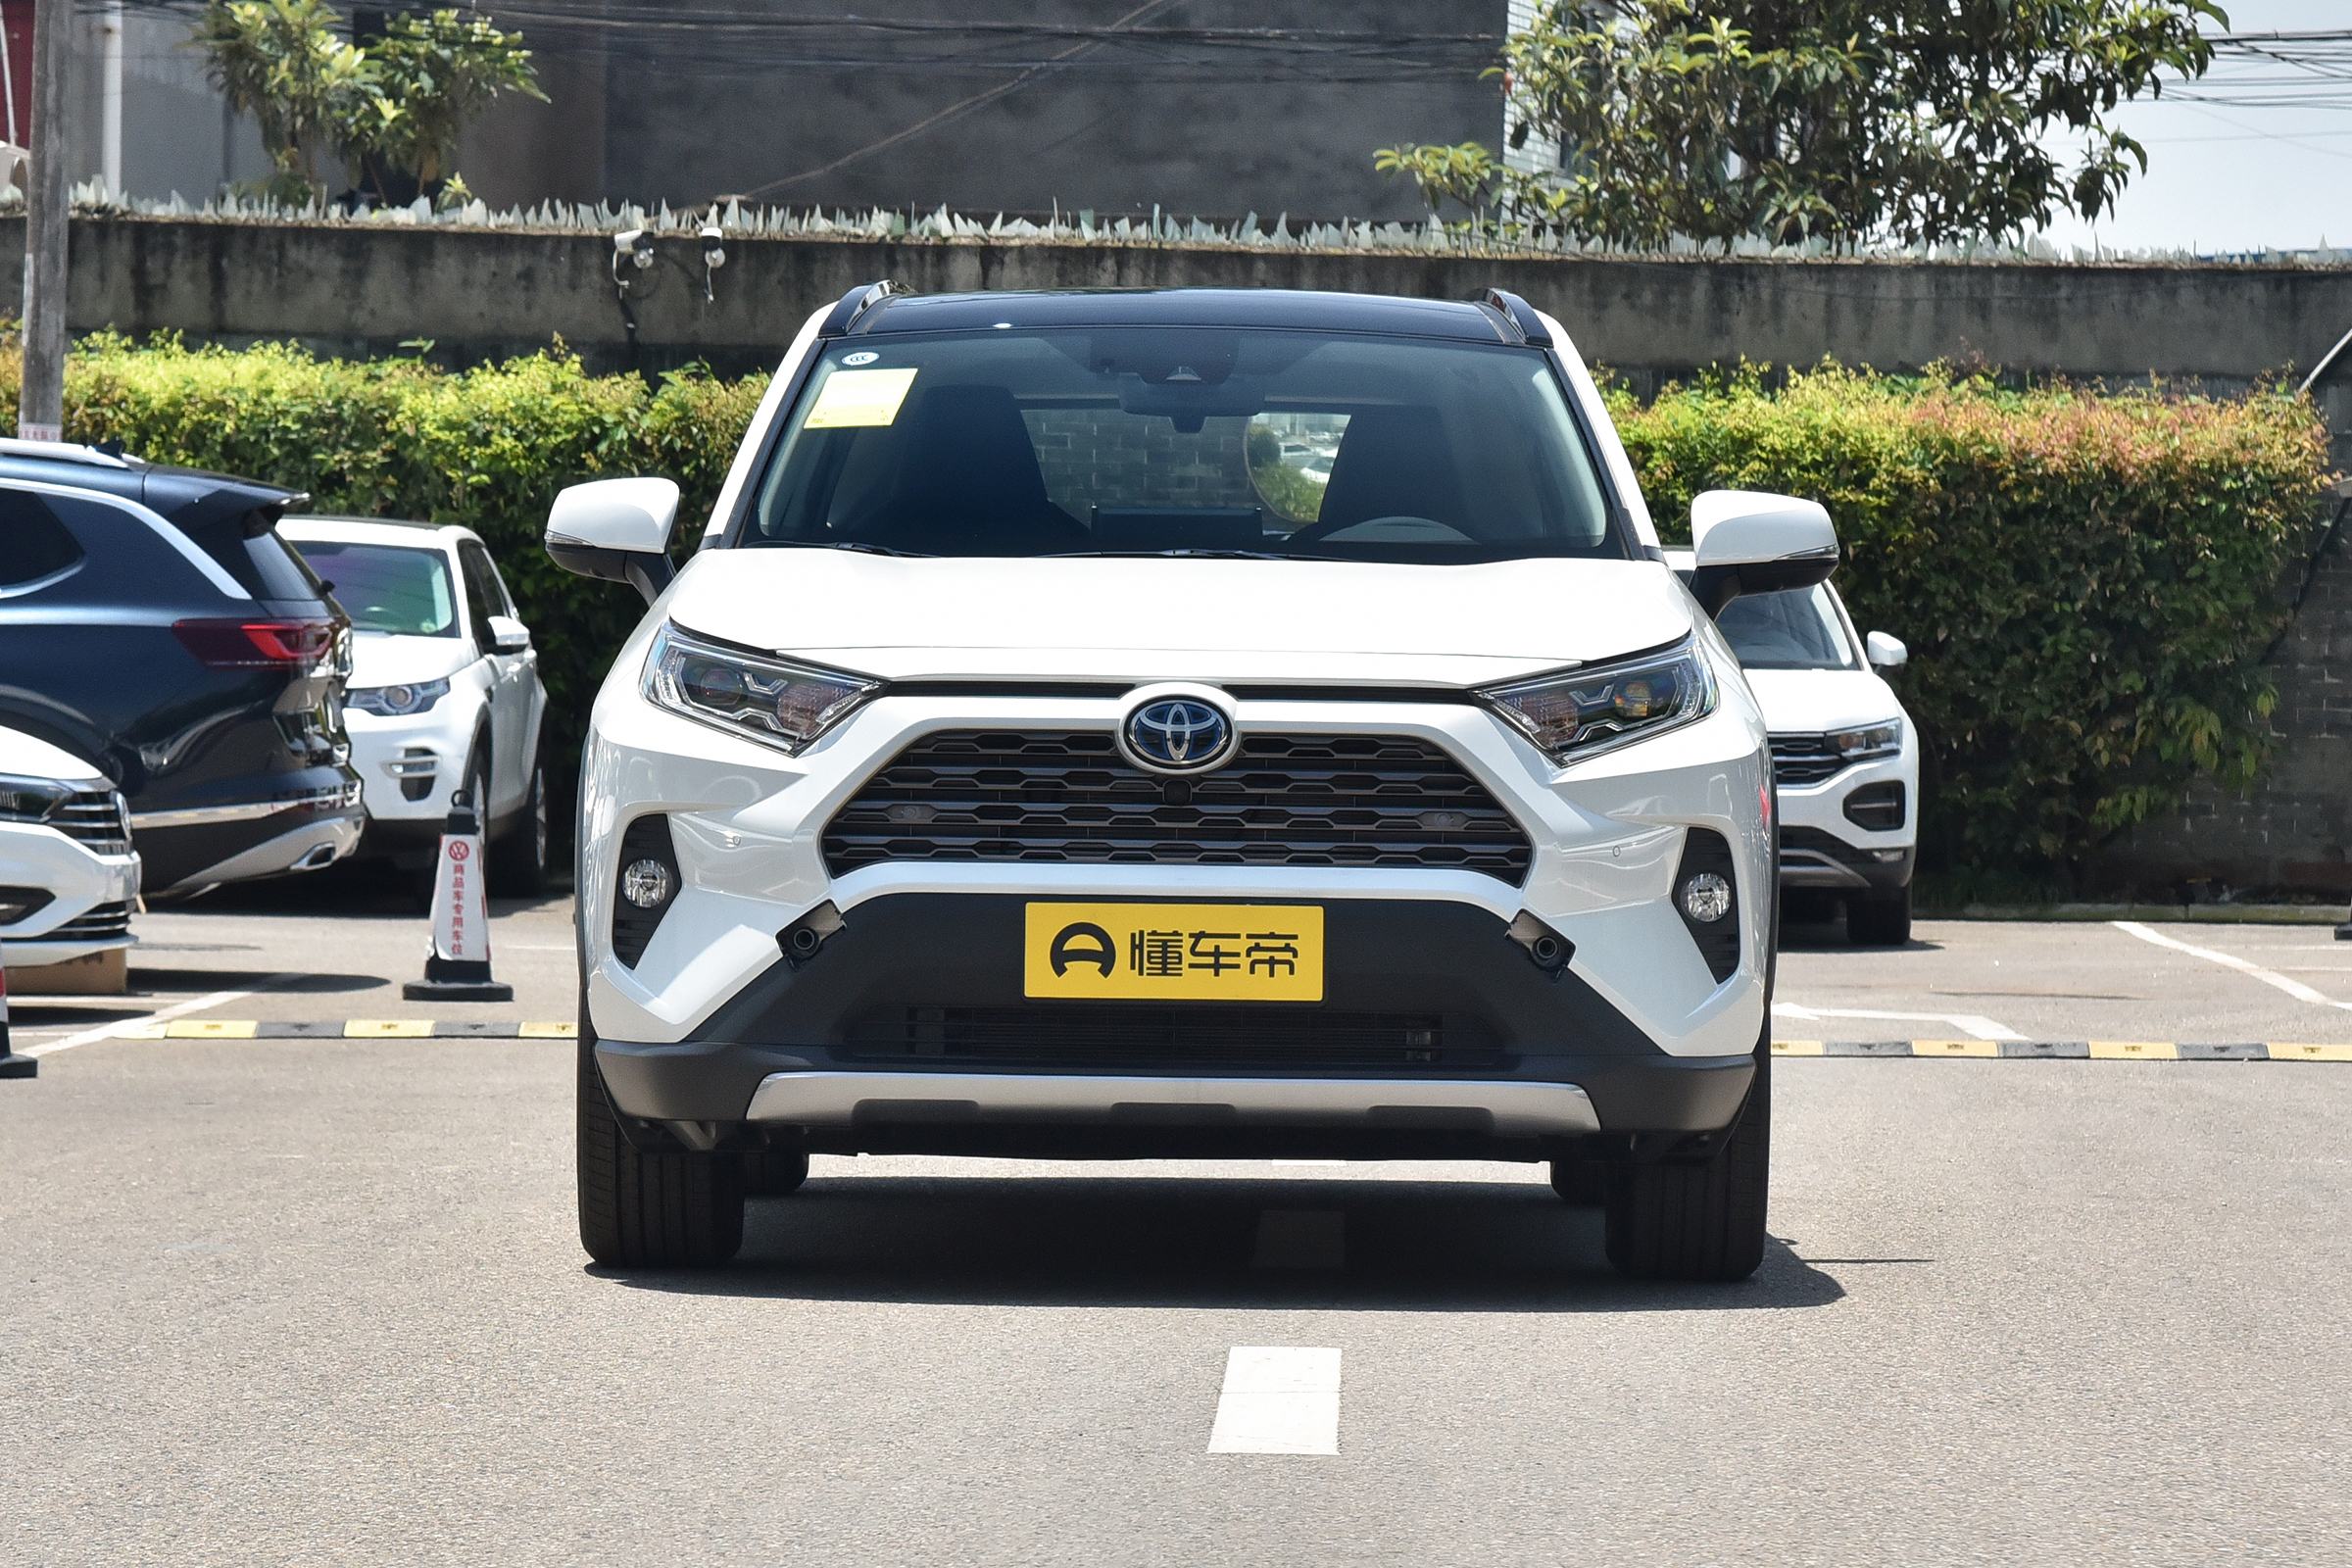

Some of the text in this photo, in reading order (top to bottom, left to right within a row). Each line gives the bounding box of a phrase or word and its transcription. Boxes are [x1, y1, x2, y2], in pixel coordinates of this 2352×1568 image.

[452, 864, 465, 955] 商品车专用车位
[1130, 930, 1298, 978] 懂车帝
